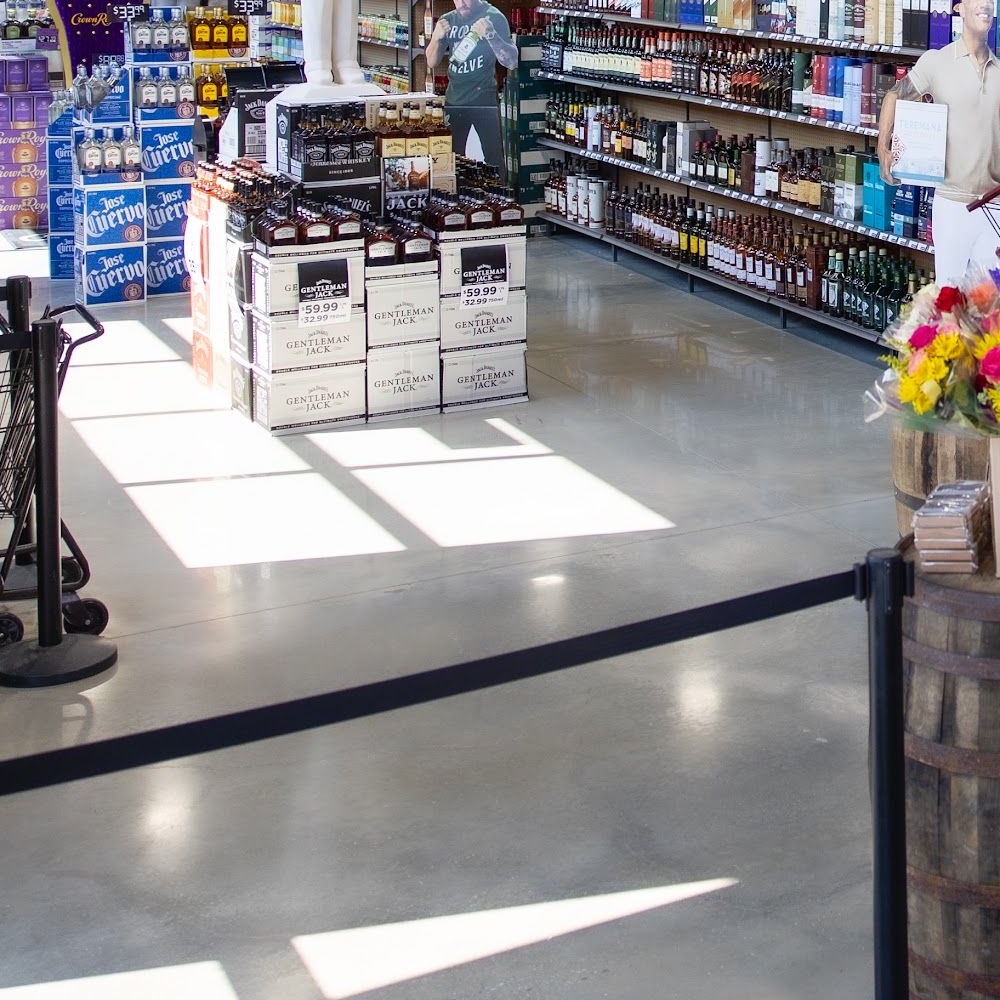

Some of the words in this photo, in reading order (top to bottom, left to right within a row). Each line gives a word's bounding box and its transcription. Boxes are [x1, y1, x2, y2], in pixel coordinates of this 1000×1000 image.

[899, 119, 942, 132] TEREMANA
[153, 131, 179, 148] Jose
[99, 194, 125, 211] Jose
[157, 189, 182, 205] Jose
[386, 198, 427, 210] JACK
[87, 202, 143, 238] Cuervo
[147, 200, 190, 230] Cuerv
[157, 246, 182, 261] Jose
[98, 253, 124, 270] Jose
[86, 261, 144, 297] Cuervo
[463, 268, 505, 277] GENTLEMAN
[301, 283, 347, 294] GENTLEMAN
[463, 286, 496, 297] $59.99
[302, 302, 338, 314] $59.99
[374, 306, 435, 320] GENTLEMAN
[301, 315, 328, 323] $32.99
[393, 316, 416, 327] JACK
[455, 316, 513, 329] GENTLEMAN
[473, 326, 496, 336] JACK
[287, 335, 350, 349] GENTLEMAN
[306, 346, 331, 356] JACK
[374, 374, 434, 388] GENTLEMAN
[457, 370, 515, 384] GENTLEMAN
[393, 384, 416, 394] JACK
[474, 380, 498, 390] JACK
[286, 390, 350, 405] GENTLEMAN
[306, 400, 332, 411] JACK
